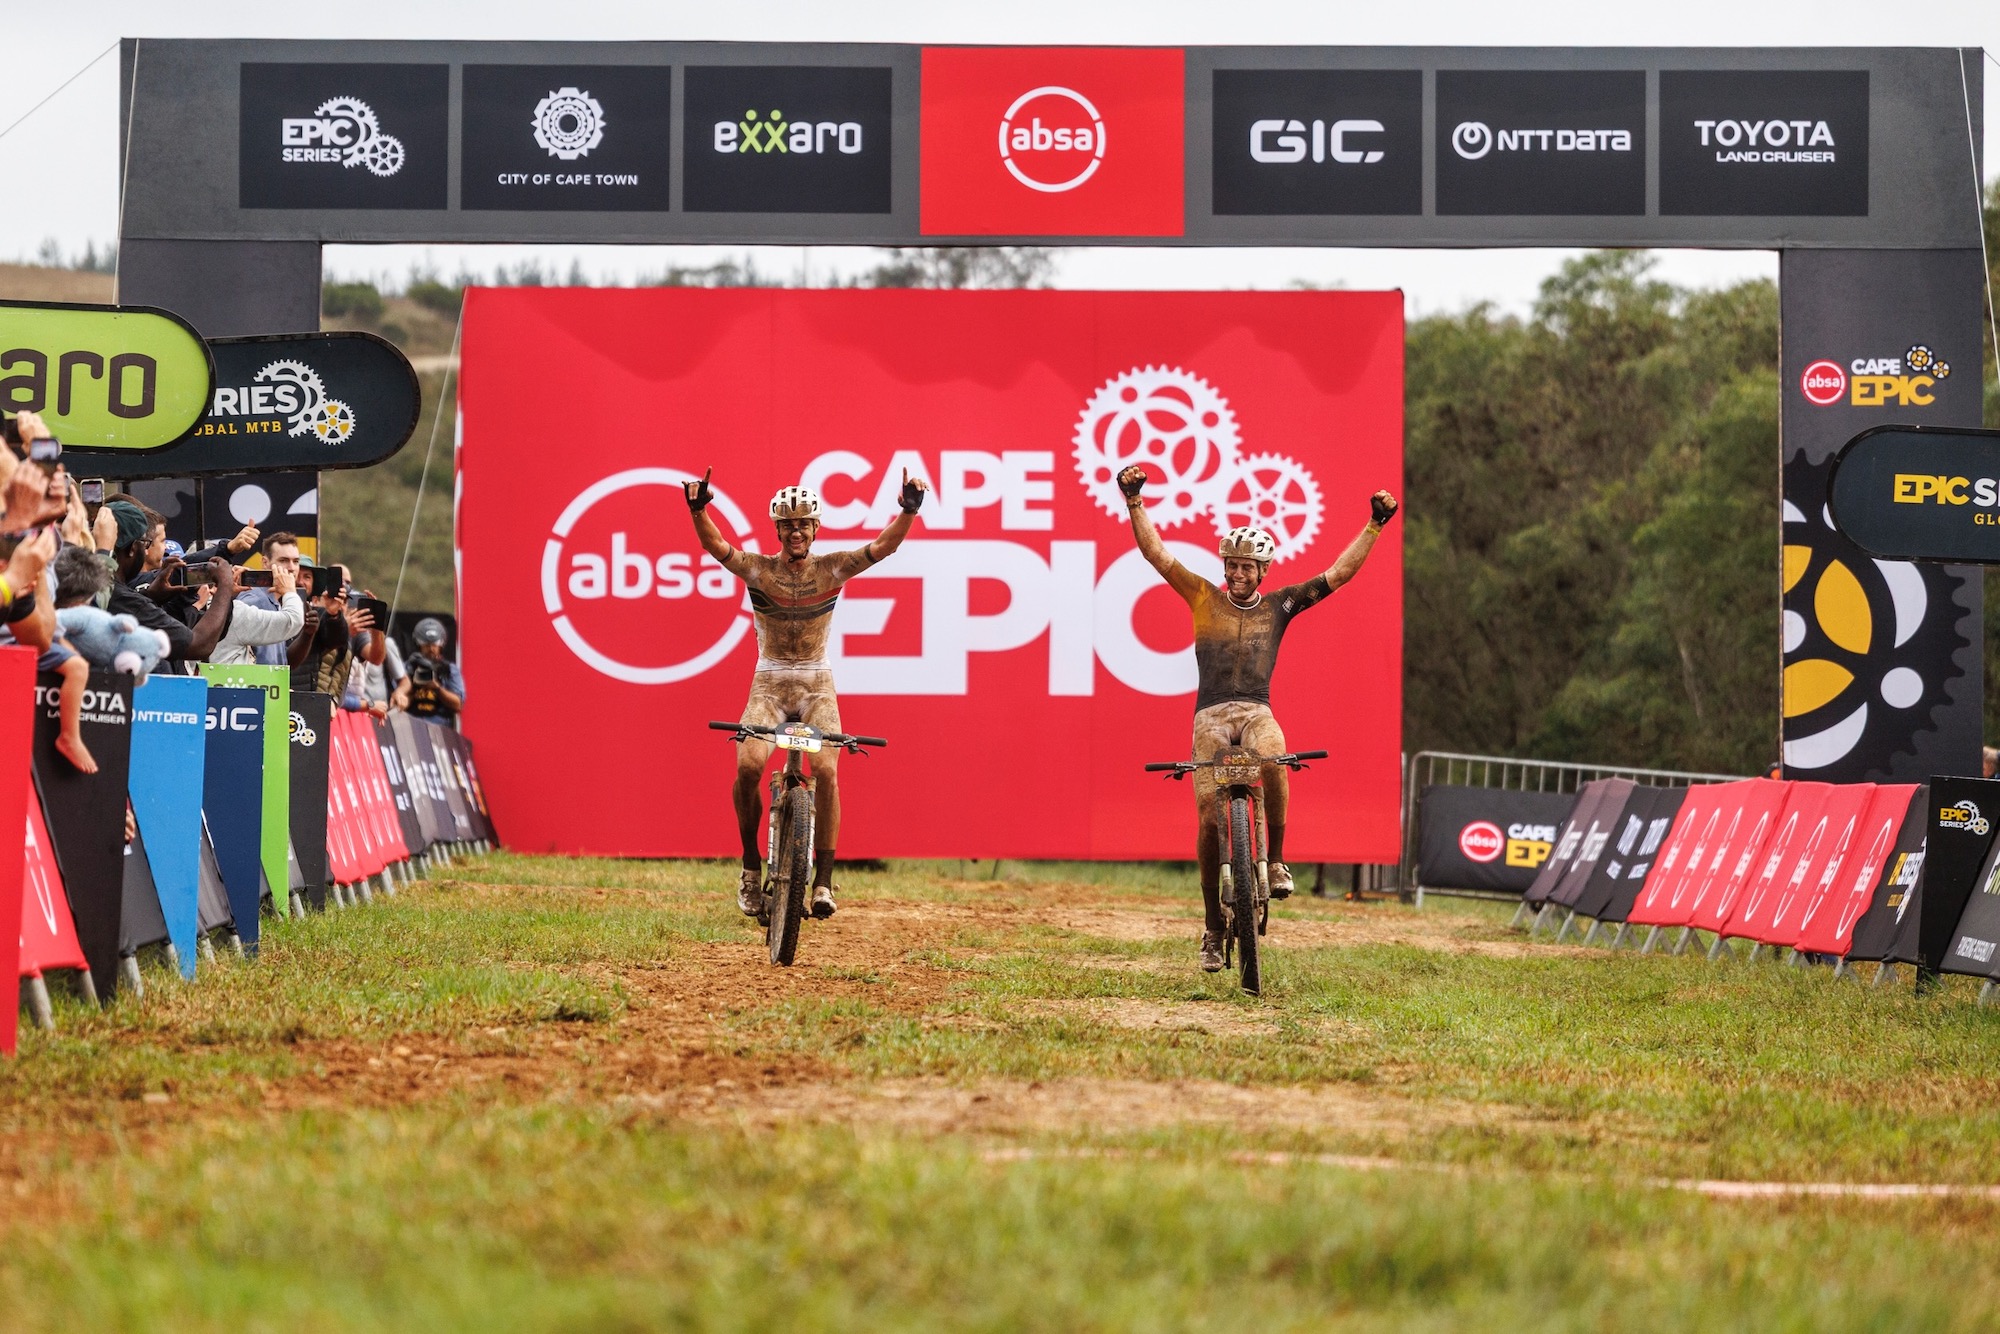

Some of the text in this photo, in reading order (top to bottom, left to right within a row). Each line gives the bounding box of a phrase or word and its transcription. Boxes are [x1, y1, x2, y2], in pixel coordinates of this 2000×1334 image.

[282, 118, 352, 146] EPIC
[714, 109, 862, 154] exxaro
[1011, 117, 1093, 151] absa
[1249, 119, 1386, 164] GIC
[1498, 129, 1553, 151] NTT
[1694, 119, 1836, 147] TOYOTA
[282, 148, 342, 163] SERIES
[1716, 151, 1836, 163] LAND CRUISER
[498, 174, 638, 186] CITY OF CAPE TOWN
[1851, 358, 1901, 375] CAPE
[1809, 373, 1841, 388] absa
[1850, 375, 1936, 406] EPIC
[246, 420, 283, 434] MTB
[799, 450, 1055, 531] CAPE
[1893, 473, 1971, 505] EPIC
[568, 532, 737, 599] absa
[810, 539, 1228, 697] EPIC
[34, 686, 126, 713] TOOTA
[138, 710, 163, 722] NTT
[788, 736, 810, 747] 15-1
[1939, 807, 1970, 822] EPIC
[1939, 820, 1965, 829] SERIES
[1466, 833, 1498, 848] absa
[1508, 823, 1556, 843] CAPE
